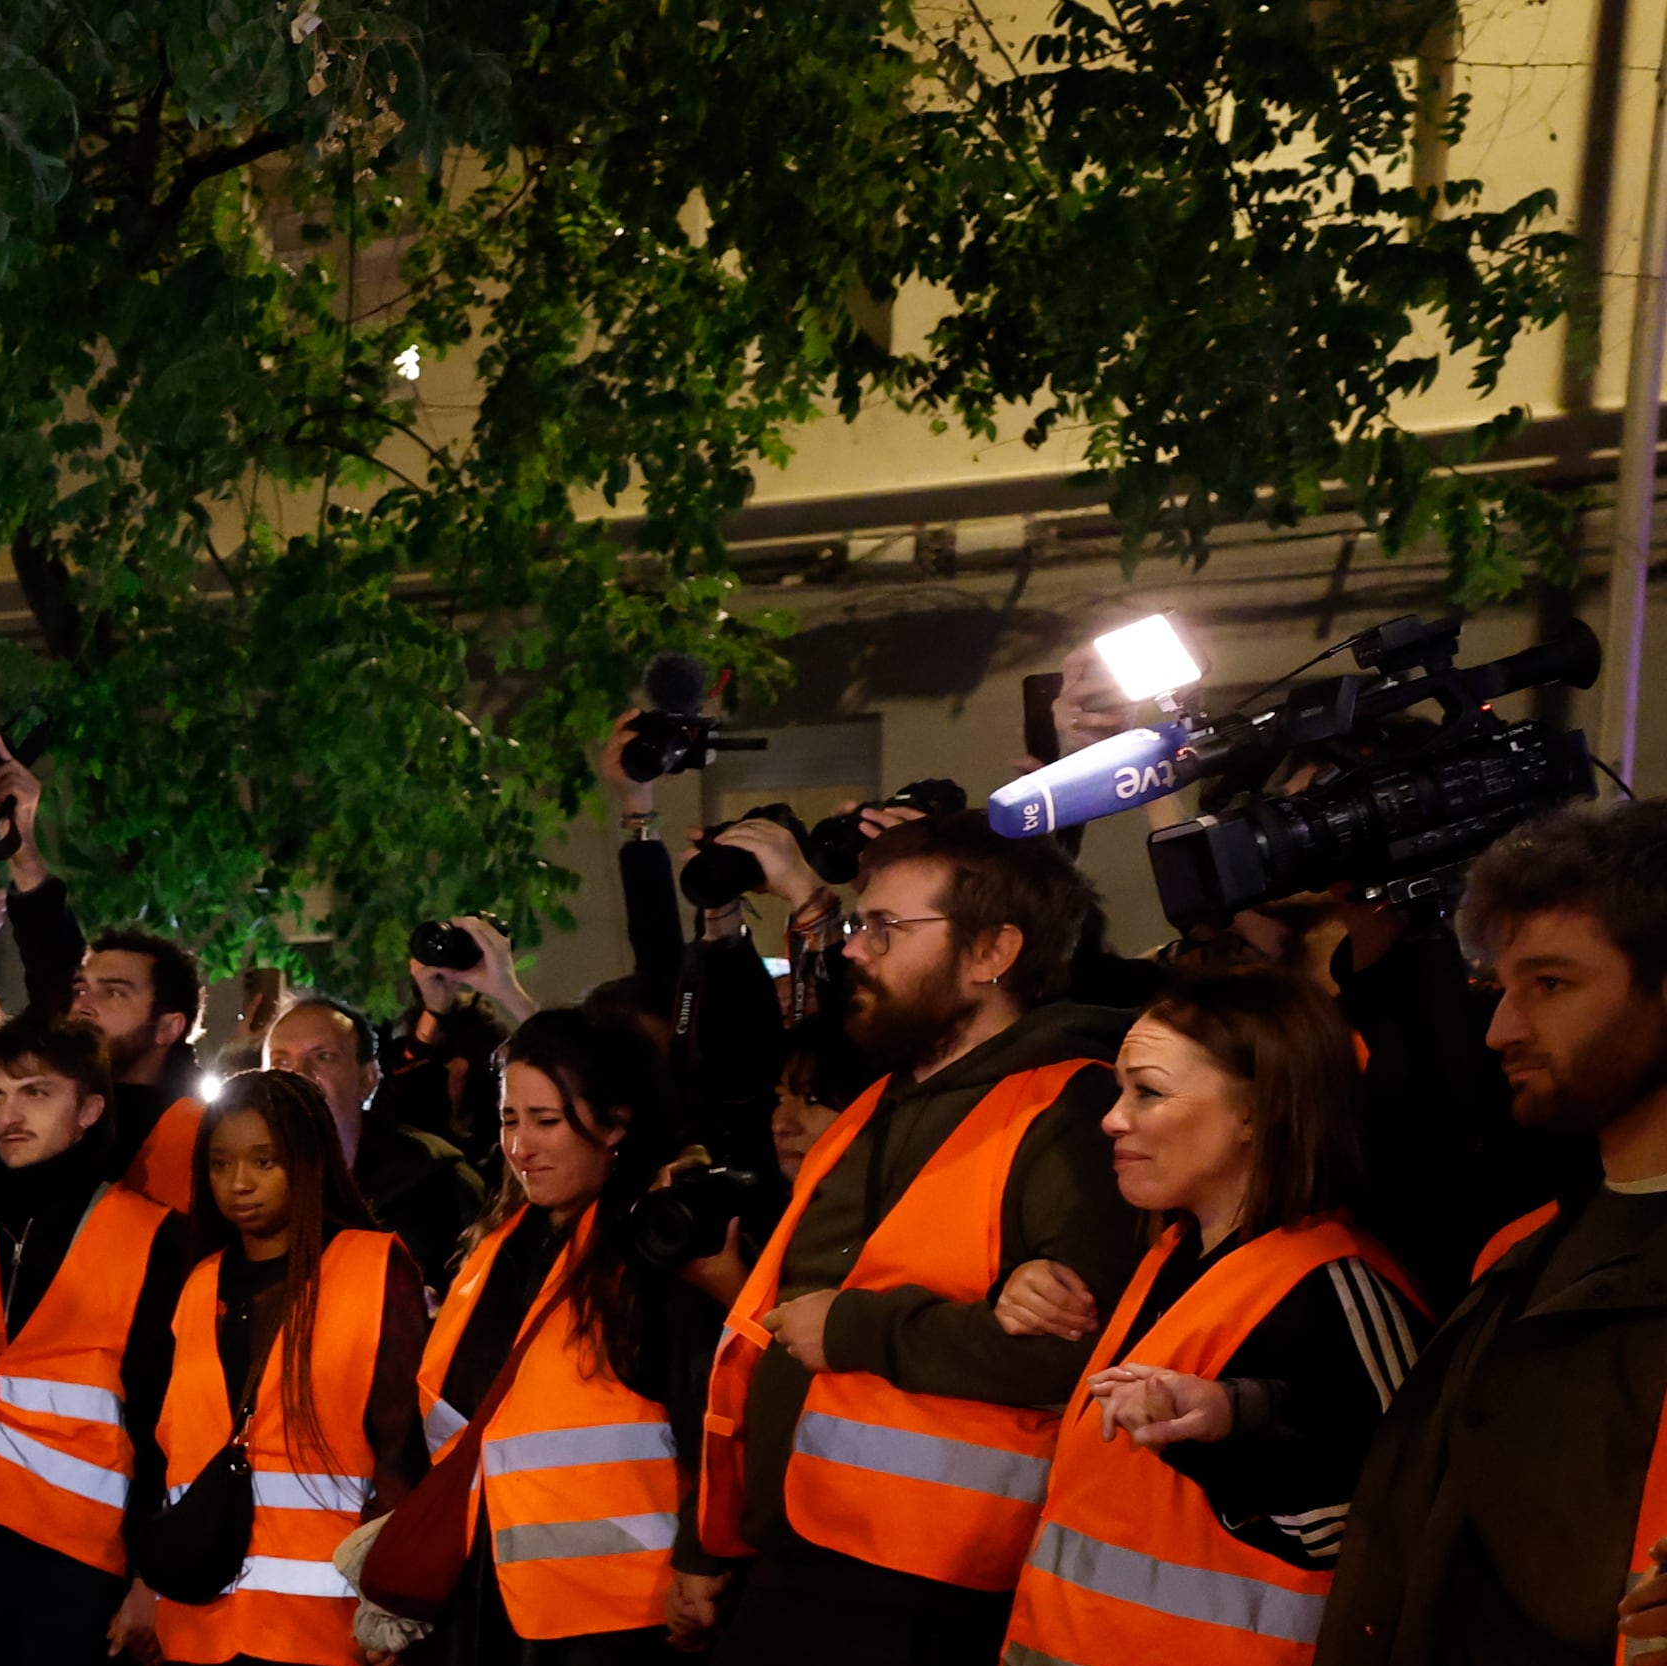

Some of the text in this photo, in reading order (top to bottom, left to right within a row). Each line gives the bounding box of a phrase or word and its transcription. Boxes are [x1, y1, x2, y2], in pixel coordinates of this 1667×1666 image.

[1114, 759, 1177, 799] tve
[1023, 802, 1040, 832] tve
[676, 992, 693, 1035] Canon
